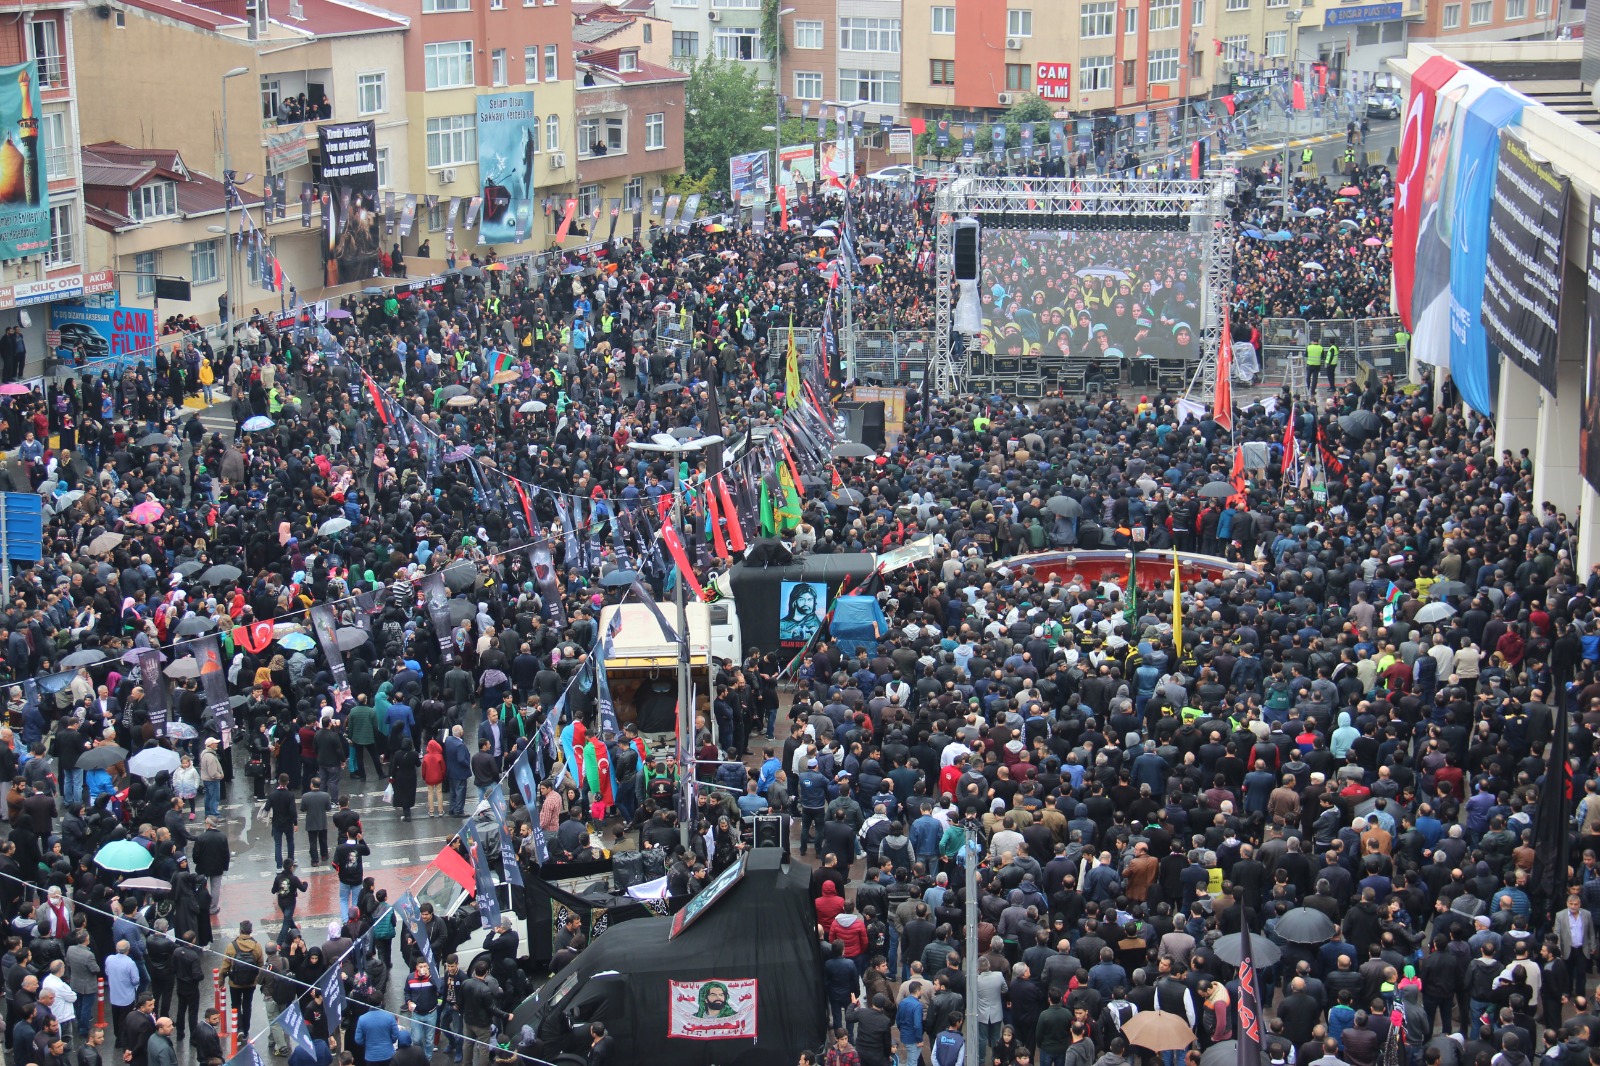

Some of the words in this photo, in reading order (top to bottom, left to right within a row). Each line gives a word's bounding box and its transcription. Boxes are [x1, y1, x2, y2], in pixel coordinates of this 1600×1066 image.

[1038, 65, 1068, 79] CAM
[1037, 81, 1068, 98] FİLMİ
[490, 98, 508, 108] Selam
[344, 126, 362, 138] Hüseyin
[339, 142, 348, 151] ona
[340, 167, 349, 176] ona
[90, 272, 106, 283] AKÜ
[31, 282, 55, 292] KILIÇ
[59, 278, 80, 288] OTO
[84, 282, 113, 293] ELEKTRİK
[112, 310, 148, 333] CAM
